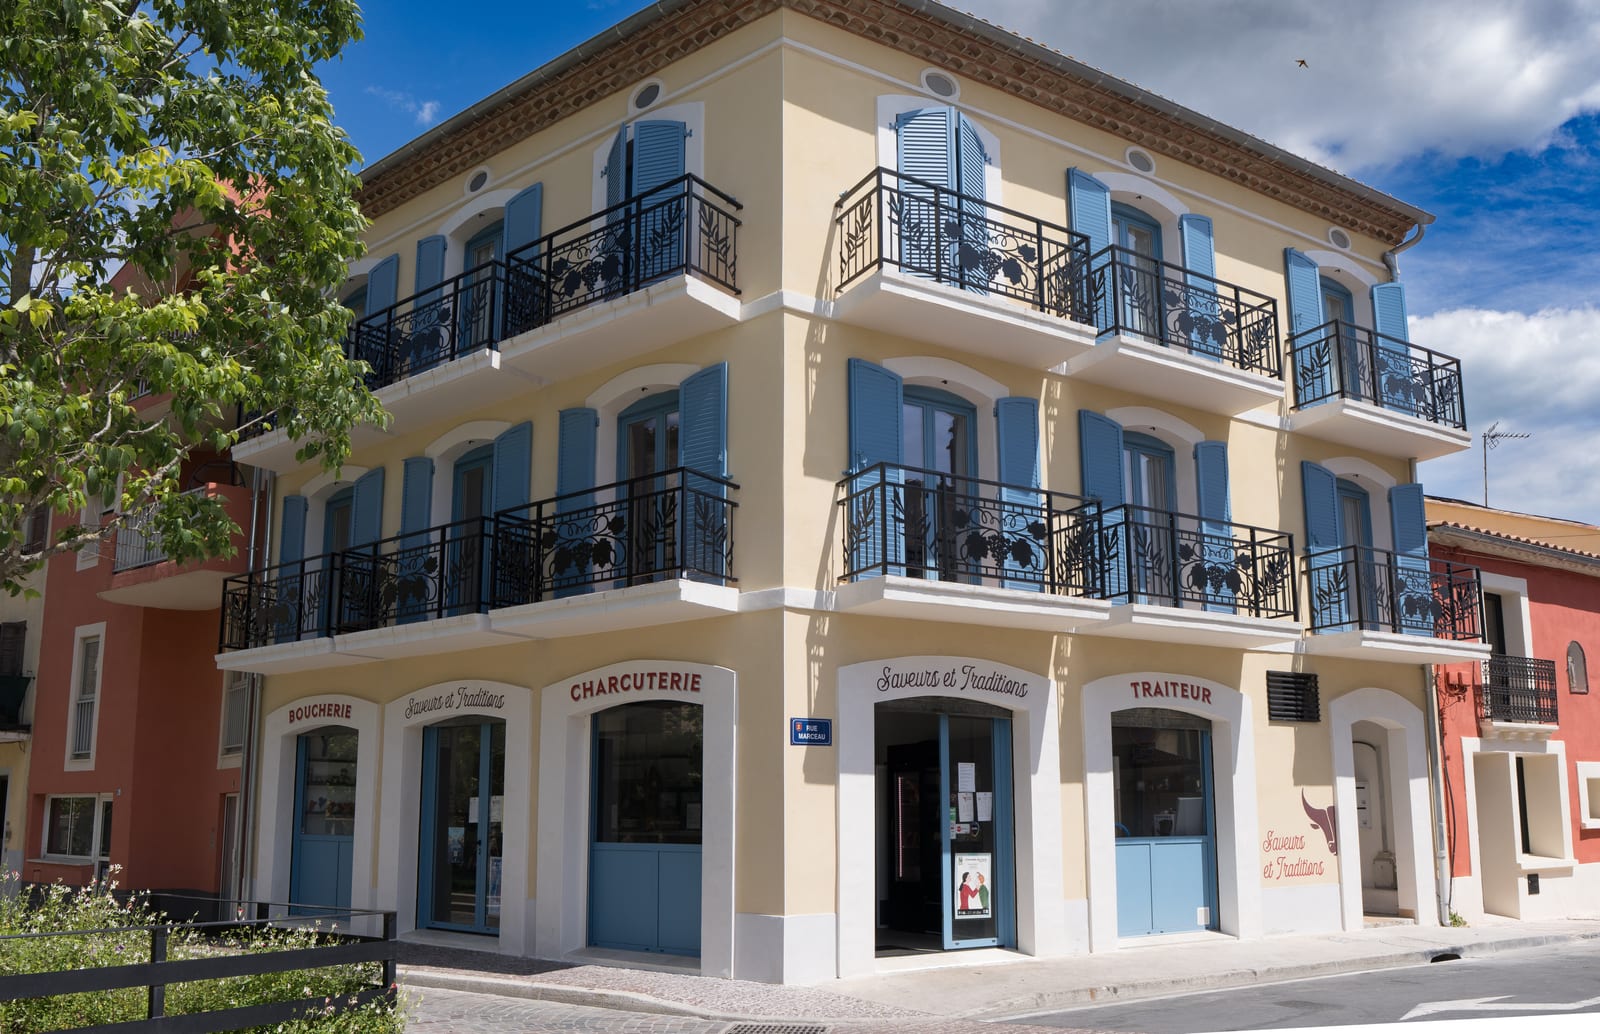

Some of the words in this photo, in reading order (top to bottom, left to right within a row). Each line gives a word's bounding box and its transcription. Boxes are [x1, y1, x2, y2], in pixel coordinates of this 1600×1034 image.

[570, 672, 702, 702] CHARCUTERIE
[876, 666, 940, 692] Saveurs
[943, 668, 956, 688] et
[960, 665, 1028, 698] Traditions
[1130, 680, 1212, 705] TRAITEUR
[288, 703, 352, 724] BOUCHERIE
[405, 694, 444, 719] Saveurs
[444, 693, 454, 708] et
[455, 687, 505, 710] Traditions
[806, 724, 818, 732] RUE
[1263, 830, 1306, 853] Saveurs
[1263, 861, 1274, 879] et
[1276, 857, 1325, 880] Traditions
